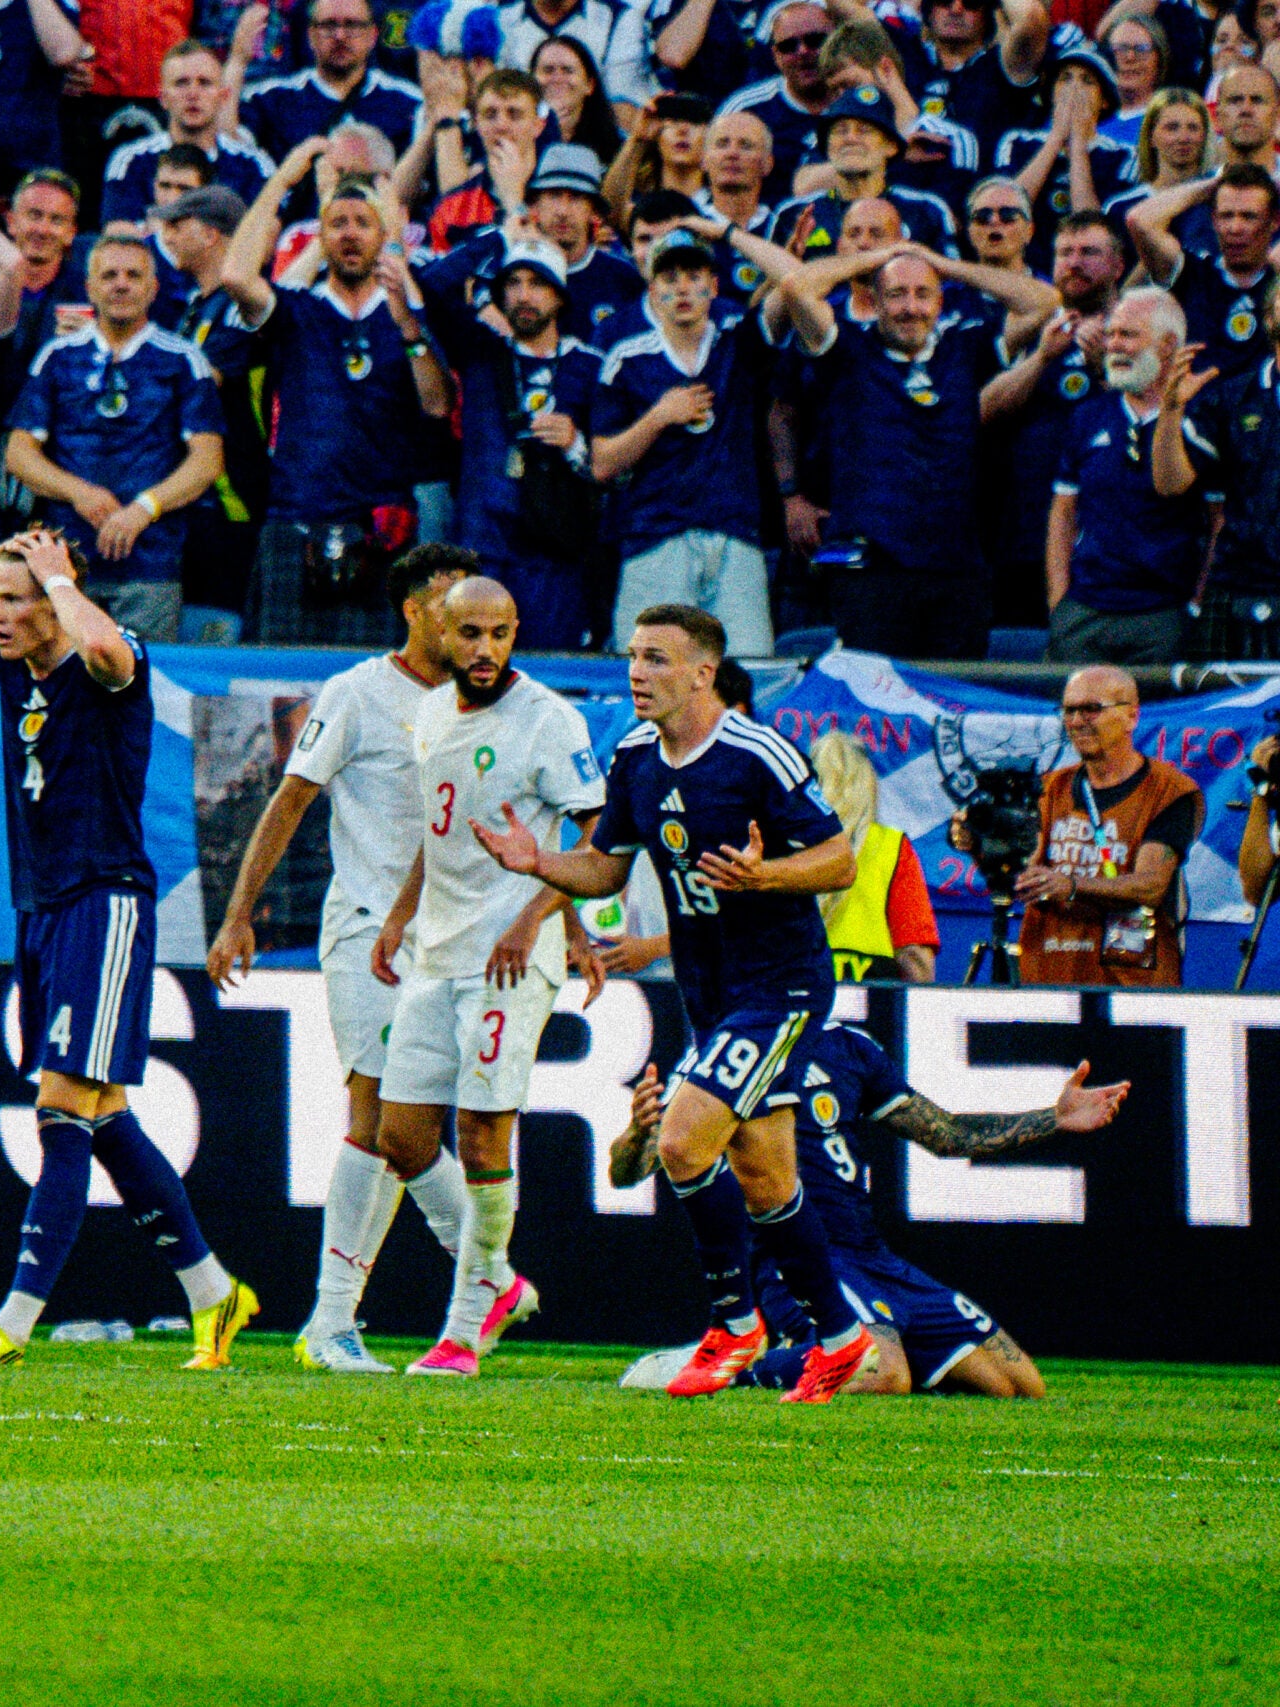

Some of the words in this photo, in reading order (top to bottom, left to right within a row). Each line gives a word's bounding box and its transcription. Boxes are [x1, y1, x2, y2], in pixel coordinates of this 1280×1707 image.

[1156, 726, 1245, 769] LEO
[22, 756, 45, 802] 4
[431, 782, 455, 836] 3
[1050, 816, 1118, 842] MEDA
[670, 869, 720, 917] 19
[49, 1004, 72, 1057] 4
[478, 1010, 506, 1064] 3
[694, 1031, 760, 1090] 19
[823, 1133, 857, 1182] 9
[953, 1292, 993, 1333] 9
